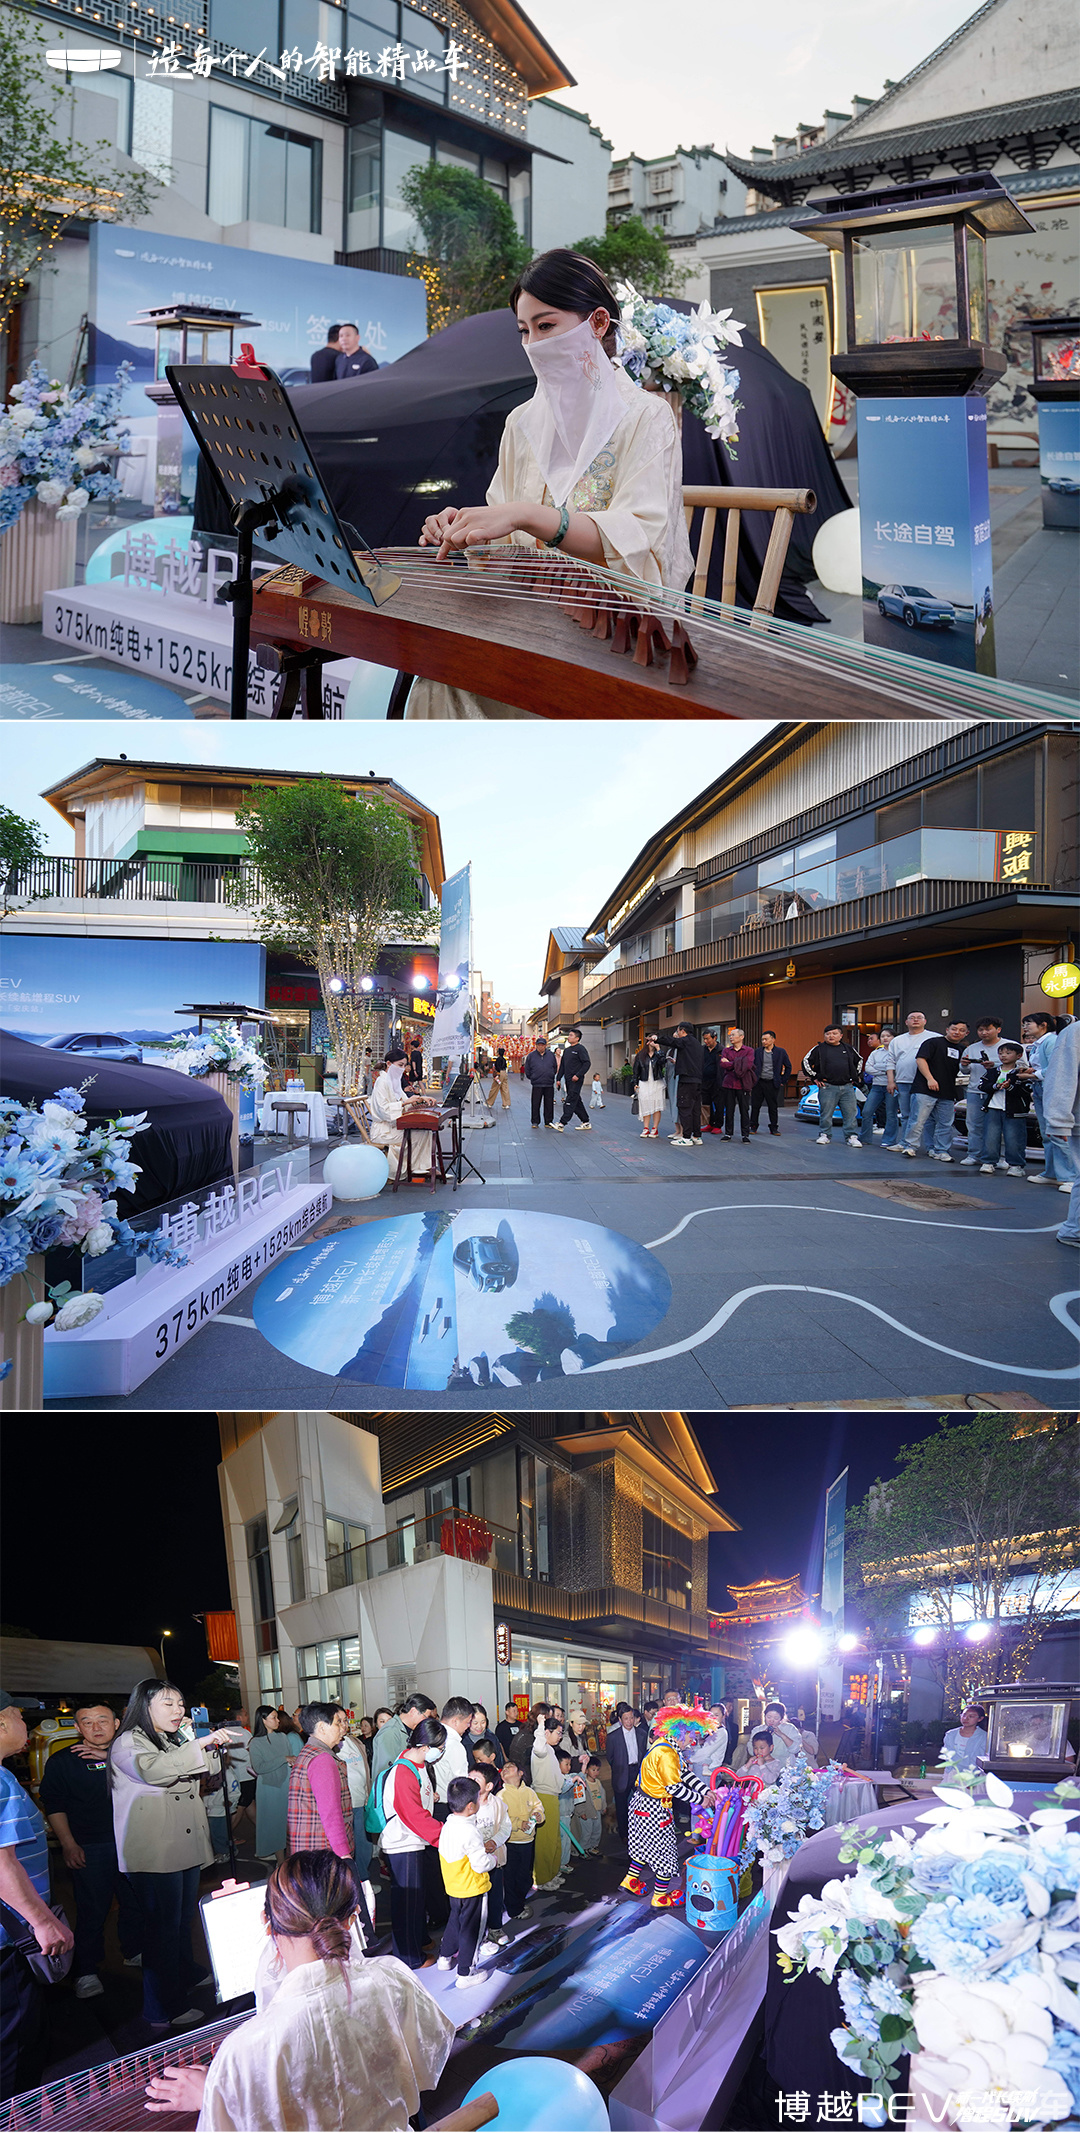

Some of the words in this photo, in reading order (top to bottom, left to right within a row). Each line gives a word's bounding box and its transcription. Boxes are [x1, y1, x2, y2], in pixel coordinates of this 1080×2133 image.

[307, 315, 387, 350] 签处
[874, 521, 955, 547] 长途自驾
[158, 1161, 294, 1256] 博越REV
[155, 1193, 328, 1359] 375km纯电+1525km综合续航
[309, 1260, 358, 1306] 博越REV
[630, 1946, 675, 1983] 博越REV
